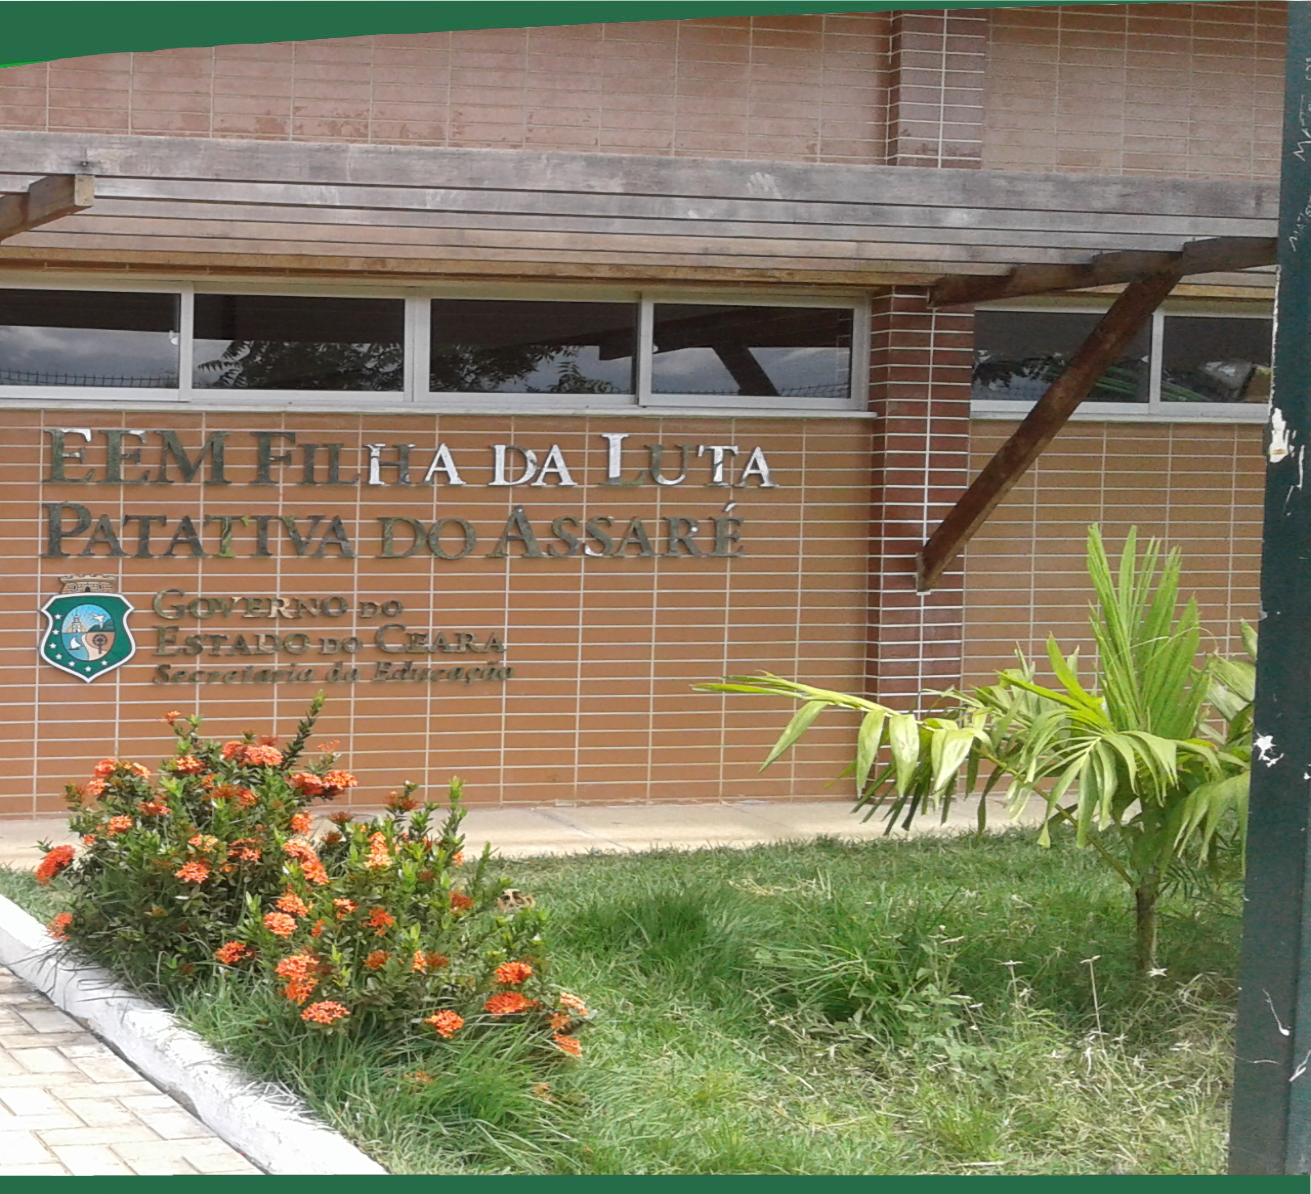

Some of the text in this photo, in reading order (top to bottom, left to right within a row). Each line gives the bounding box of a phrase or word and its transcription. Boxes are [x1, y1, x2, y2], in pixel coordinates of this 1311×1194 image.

[42, 428, 780, 489] EEM FILHA DA LUTA
[40, 500, 745, 561] PATATIVA DO ASSARÉ
